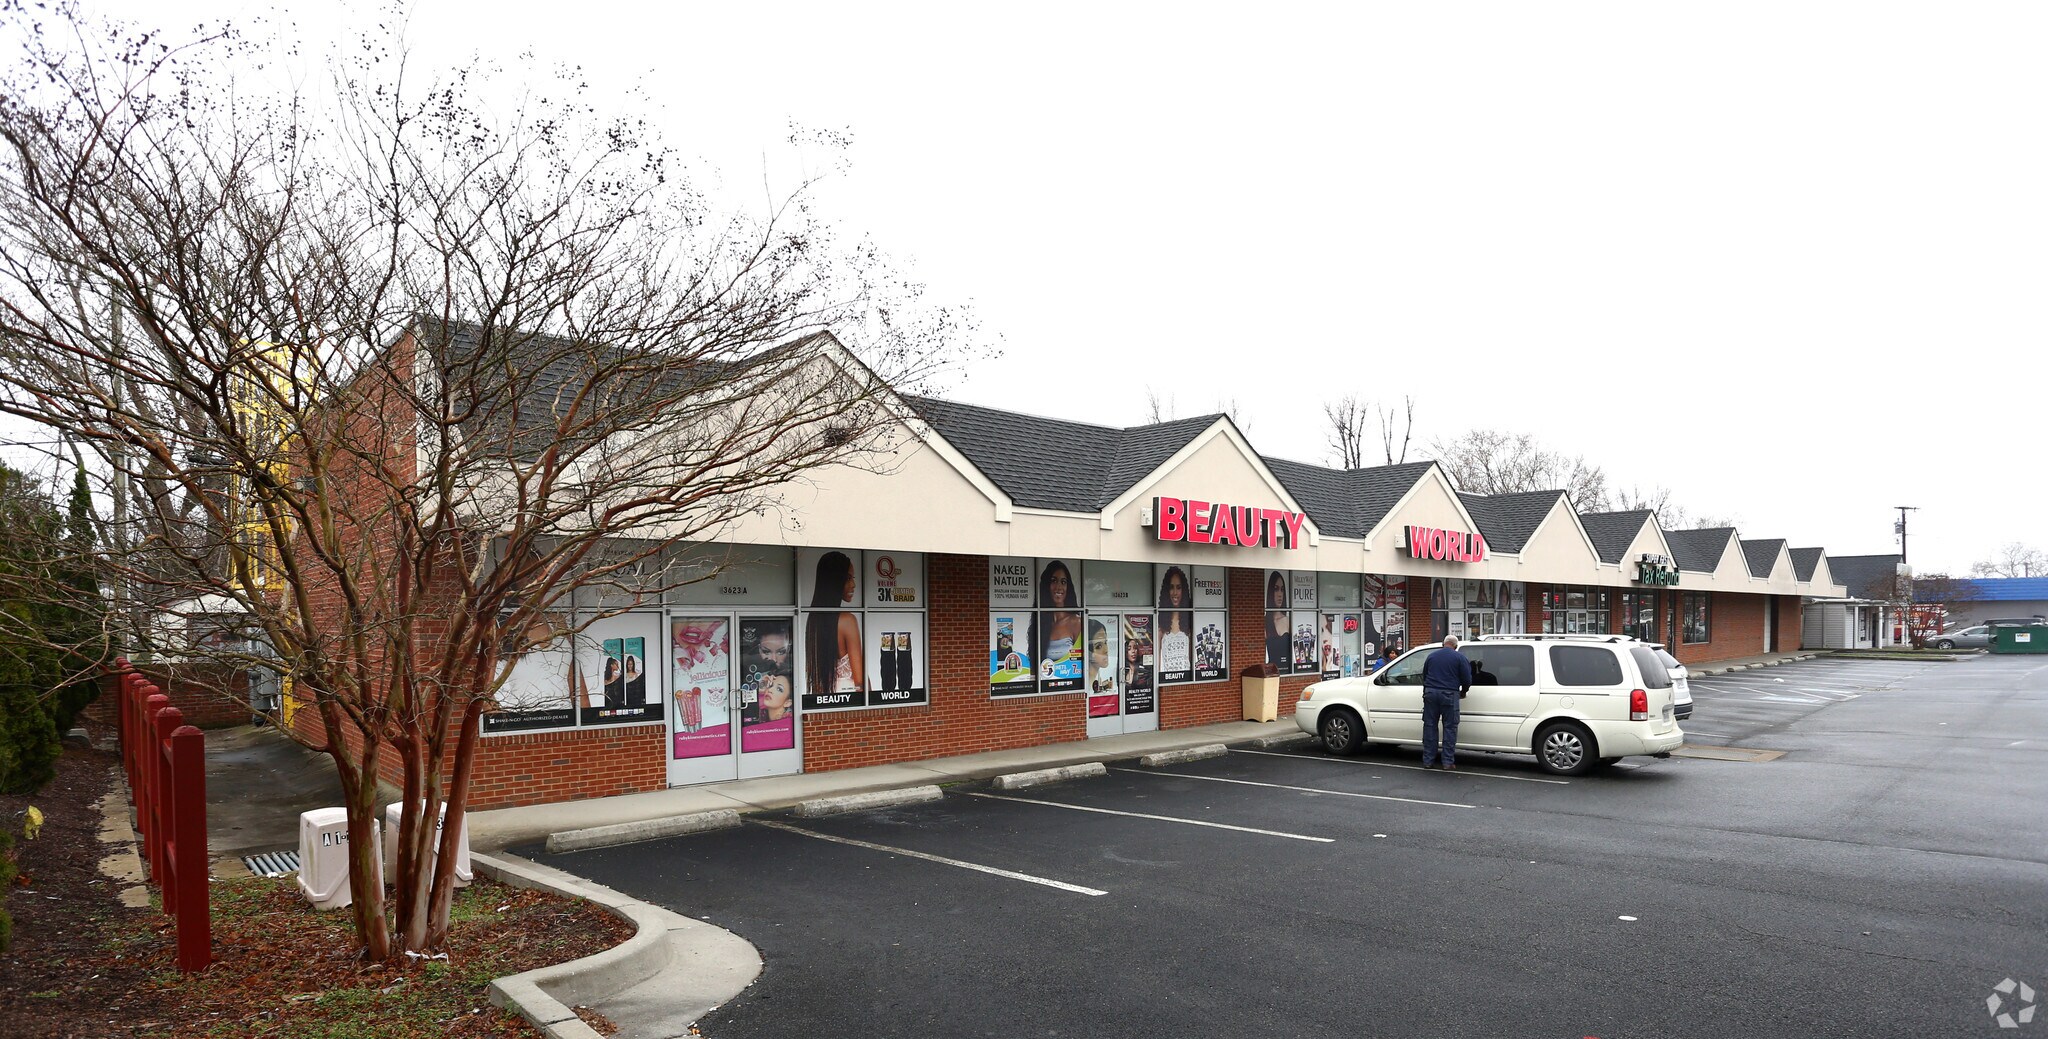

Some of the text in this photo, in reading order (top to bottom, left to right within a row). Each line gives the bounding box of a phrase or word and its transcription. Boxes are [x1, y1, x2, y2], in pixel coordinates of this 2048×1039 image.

[1155, 496, 1306, 550] BEAUTY
[1406, 525, 1485, 563] WORLD
[993, 564, 1027, 576] NAKED
[993, 576, 1029, 587] NATURE
[1655, 567, 1680, 586] Refund
[877, 587, 892, 602] 3X
[893, 594, 916, 602] BRAID
[1205, 588, 1222, 596] BRAID
[1293, 588, 1315, 600] PURE
[1343, 619, 1359, 631] OPEN
[1164, 672, 1185, 680] BEAUTY
[816, 691, 910, 704] BEAUTY WORLD
[322, 832, 332, 847] A
